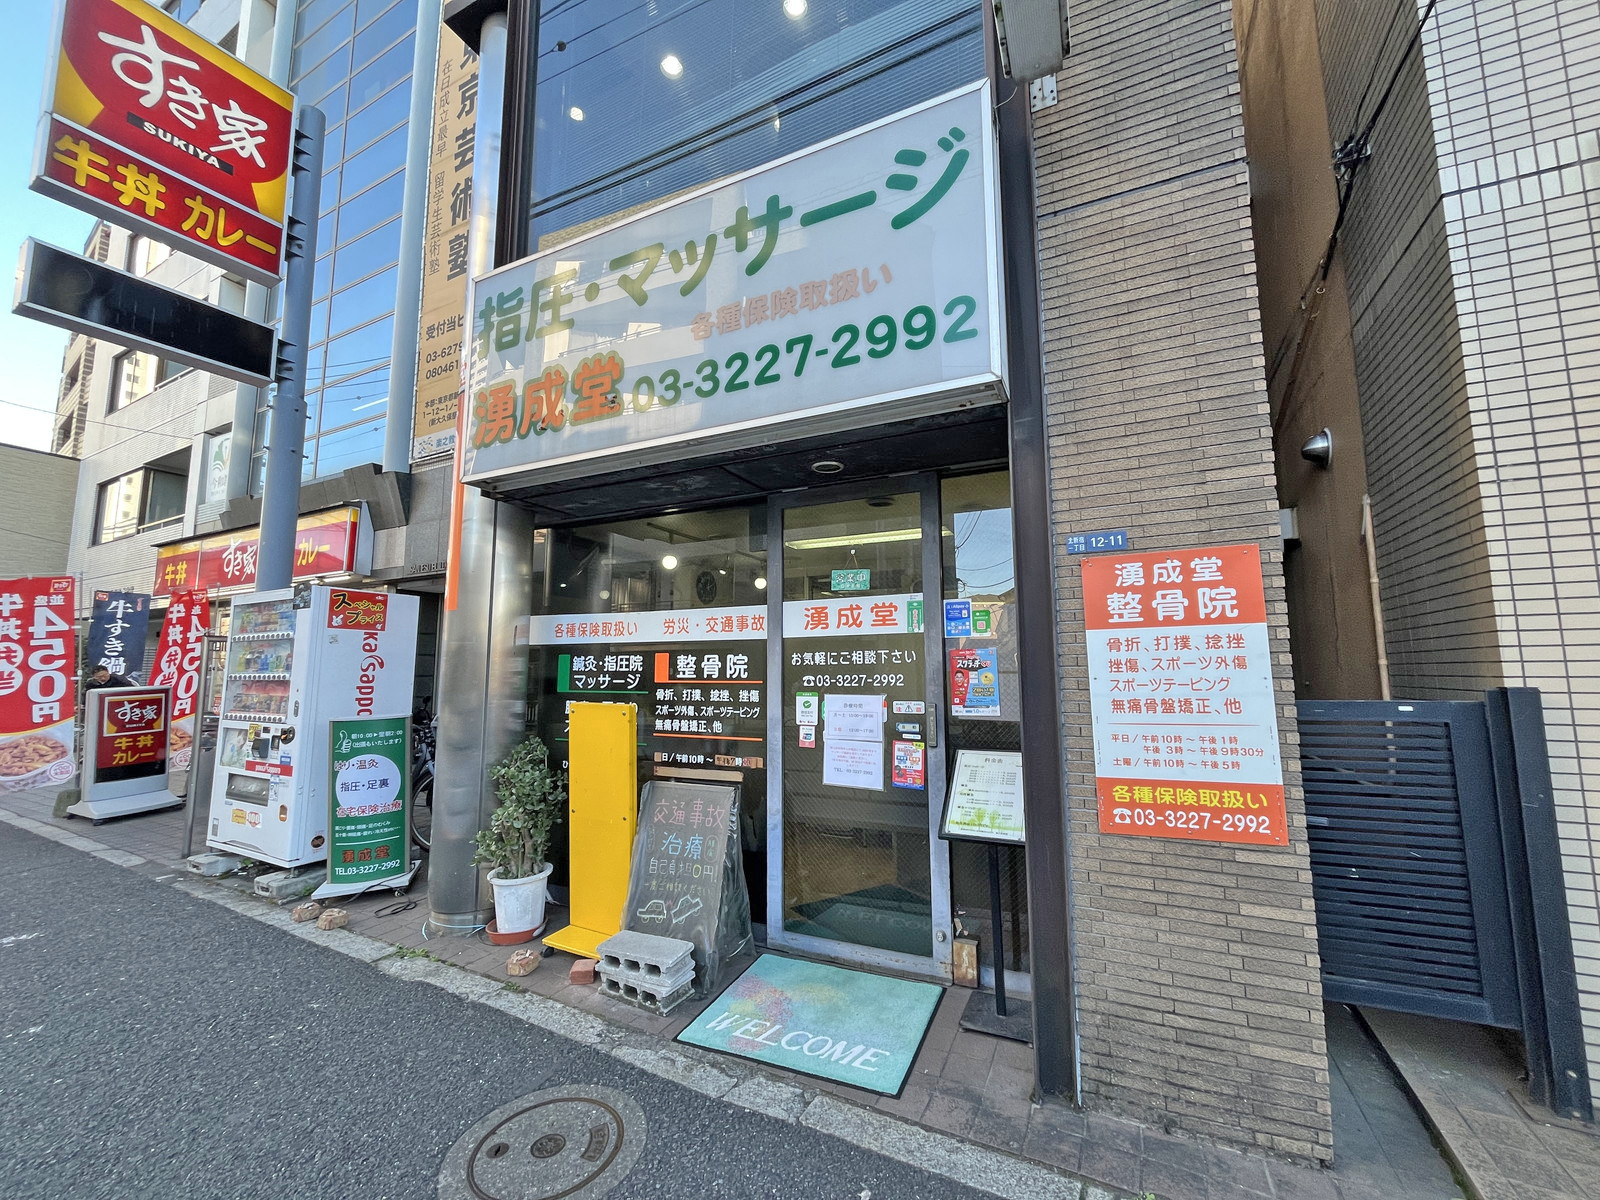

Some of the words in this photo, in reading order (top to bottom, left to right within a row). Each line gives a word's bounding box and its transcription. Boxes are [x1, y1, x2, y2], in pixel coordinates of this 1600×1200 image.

[97, 24, 268, 168] すき家
[143, 121, 221, 169] SUKIYA
[53, 134, 167, 217] 牛丼
[181, 195, 277, 254] カレー
[478, 127, 971, 360] 指圧・マッサージ
[690, 263, 893, 341] 各種保険取扱い
[631, 294, 979, 413] 03-3227-2992
[426, 359, 459, 379] 080461
[472, 350, 624, 448] 湧成堂
[1068, 544, 1085, 552] 一丁目
[1091, 535, 1123, 547] 12-11
[165, 561, 187, 586] 牛丼
[297, 537, 331, 567] カレー
[1114, 556, 1224, 587] 湧成堂
[803, 602, 898, 630] 湧成堂
[1107, 585, 1240, 623] 整骨院
[554, 620, 638, 639] 各種保険取扱い
[663, 614, 765, 635] 労災・交通事故
[98, 600, 134, 676] 牛すき鍋
[1106, 633, 1246, 653] 骨折、打撲、捻挫
[572, 655, 643, 672] 鍼灸・指圧院
[676, 654, 749, 679] 整骨院
[791, 650, 916, 666] お気軽にご相談下さい
[1108, 655, 1248, 674] 挫傷、スポーツ外傷
[573, 674, 641, 690] マッサージ
[816, 674, 905, 686] 03-3227-2992
[1109, 676, 1231, 692] スポーツテーピング
[115, 701, 158, 724] すき家
[1110, 697, 1243, 715] 無痛骨盤矯正、他
[114, 734, 154, 750] 牛丼
[112, 750, 155, 765] カレー
[341, 778, 390, 792] 指圧・足裏
[1112, 785, 1268, 809] 各種保険取扱い
[654, 798, 725, 829] 交通事故
[1134, 808, 1271, 834] 03-3227-2992
[661, 831, 704, 860] 治療
[705, 1011, 890, 1072] WELCOME
